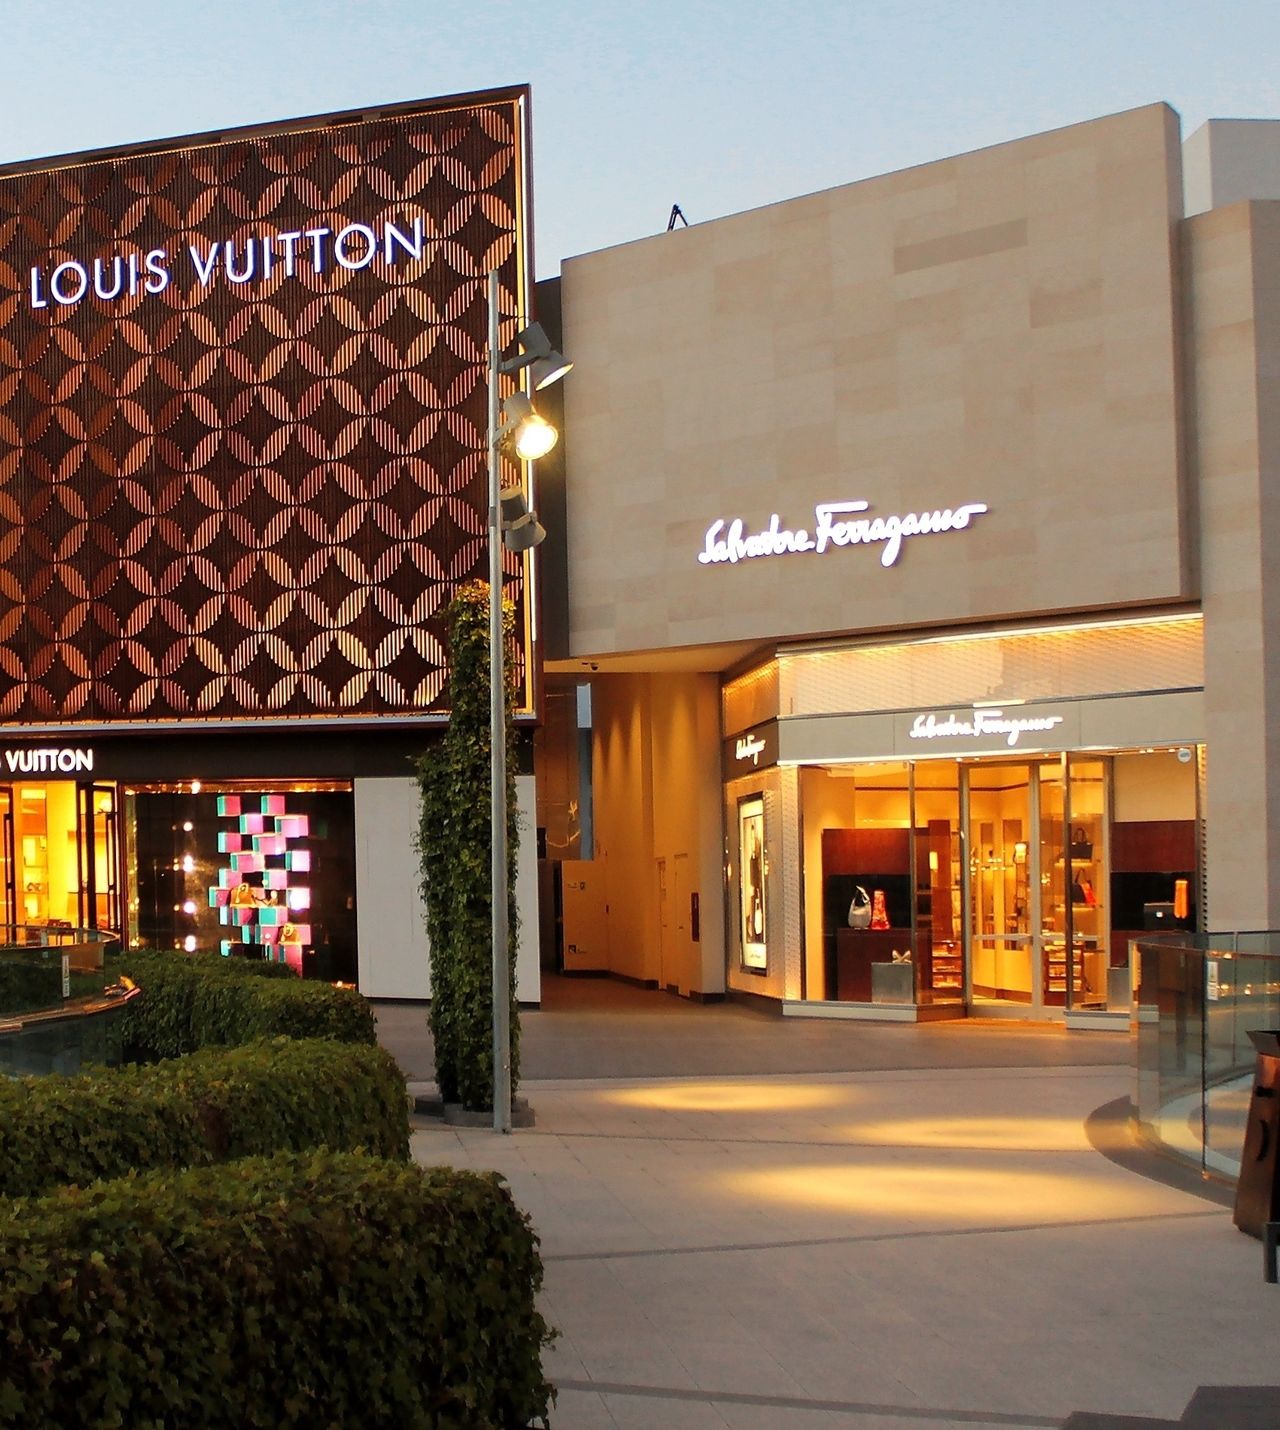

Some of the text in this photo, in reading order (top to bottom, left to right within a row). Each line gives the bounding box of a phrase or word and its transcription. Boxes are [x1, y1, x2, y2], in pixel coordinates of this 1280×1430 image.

[30, 218, 424, 309] LOUIS VUITTON
[697, 500, 988, 567] Salvatore Ferragamo
[4, 748, 94, 773] VUITTON
